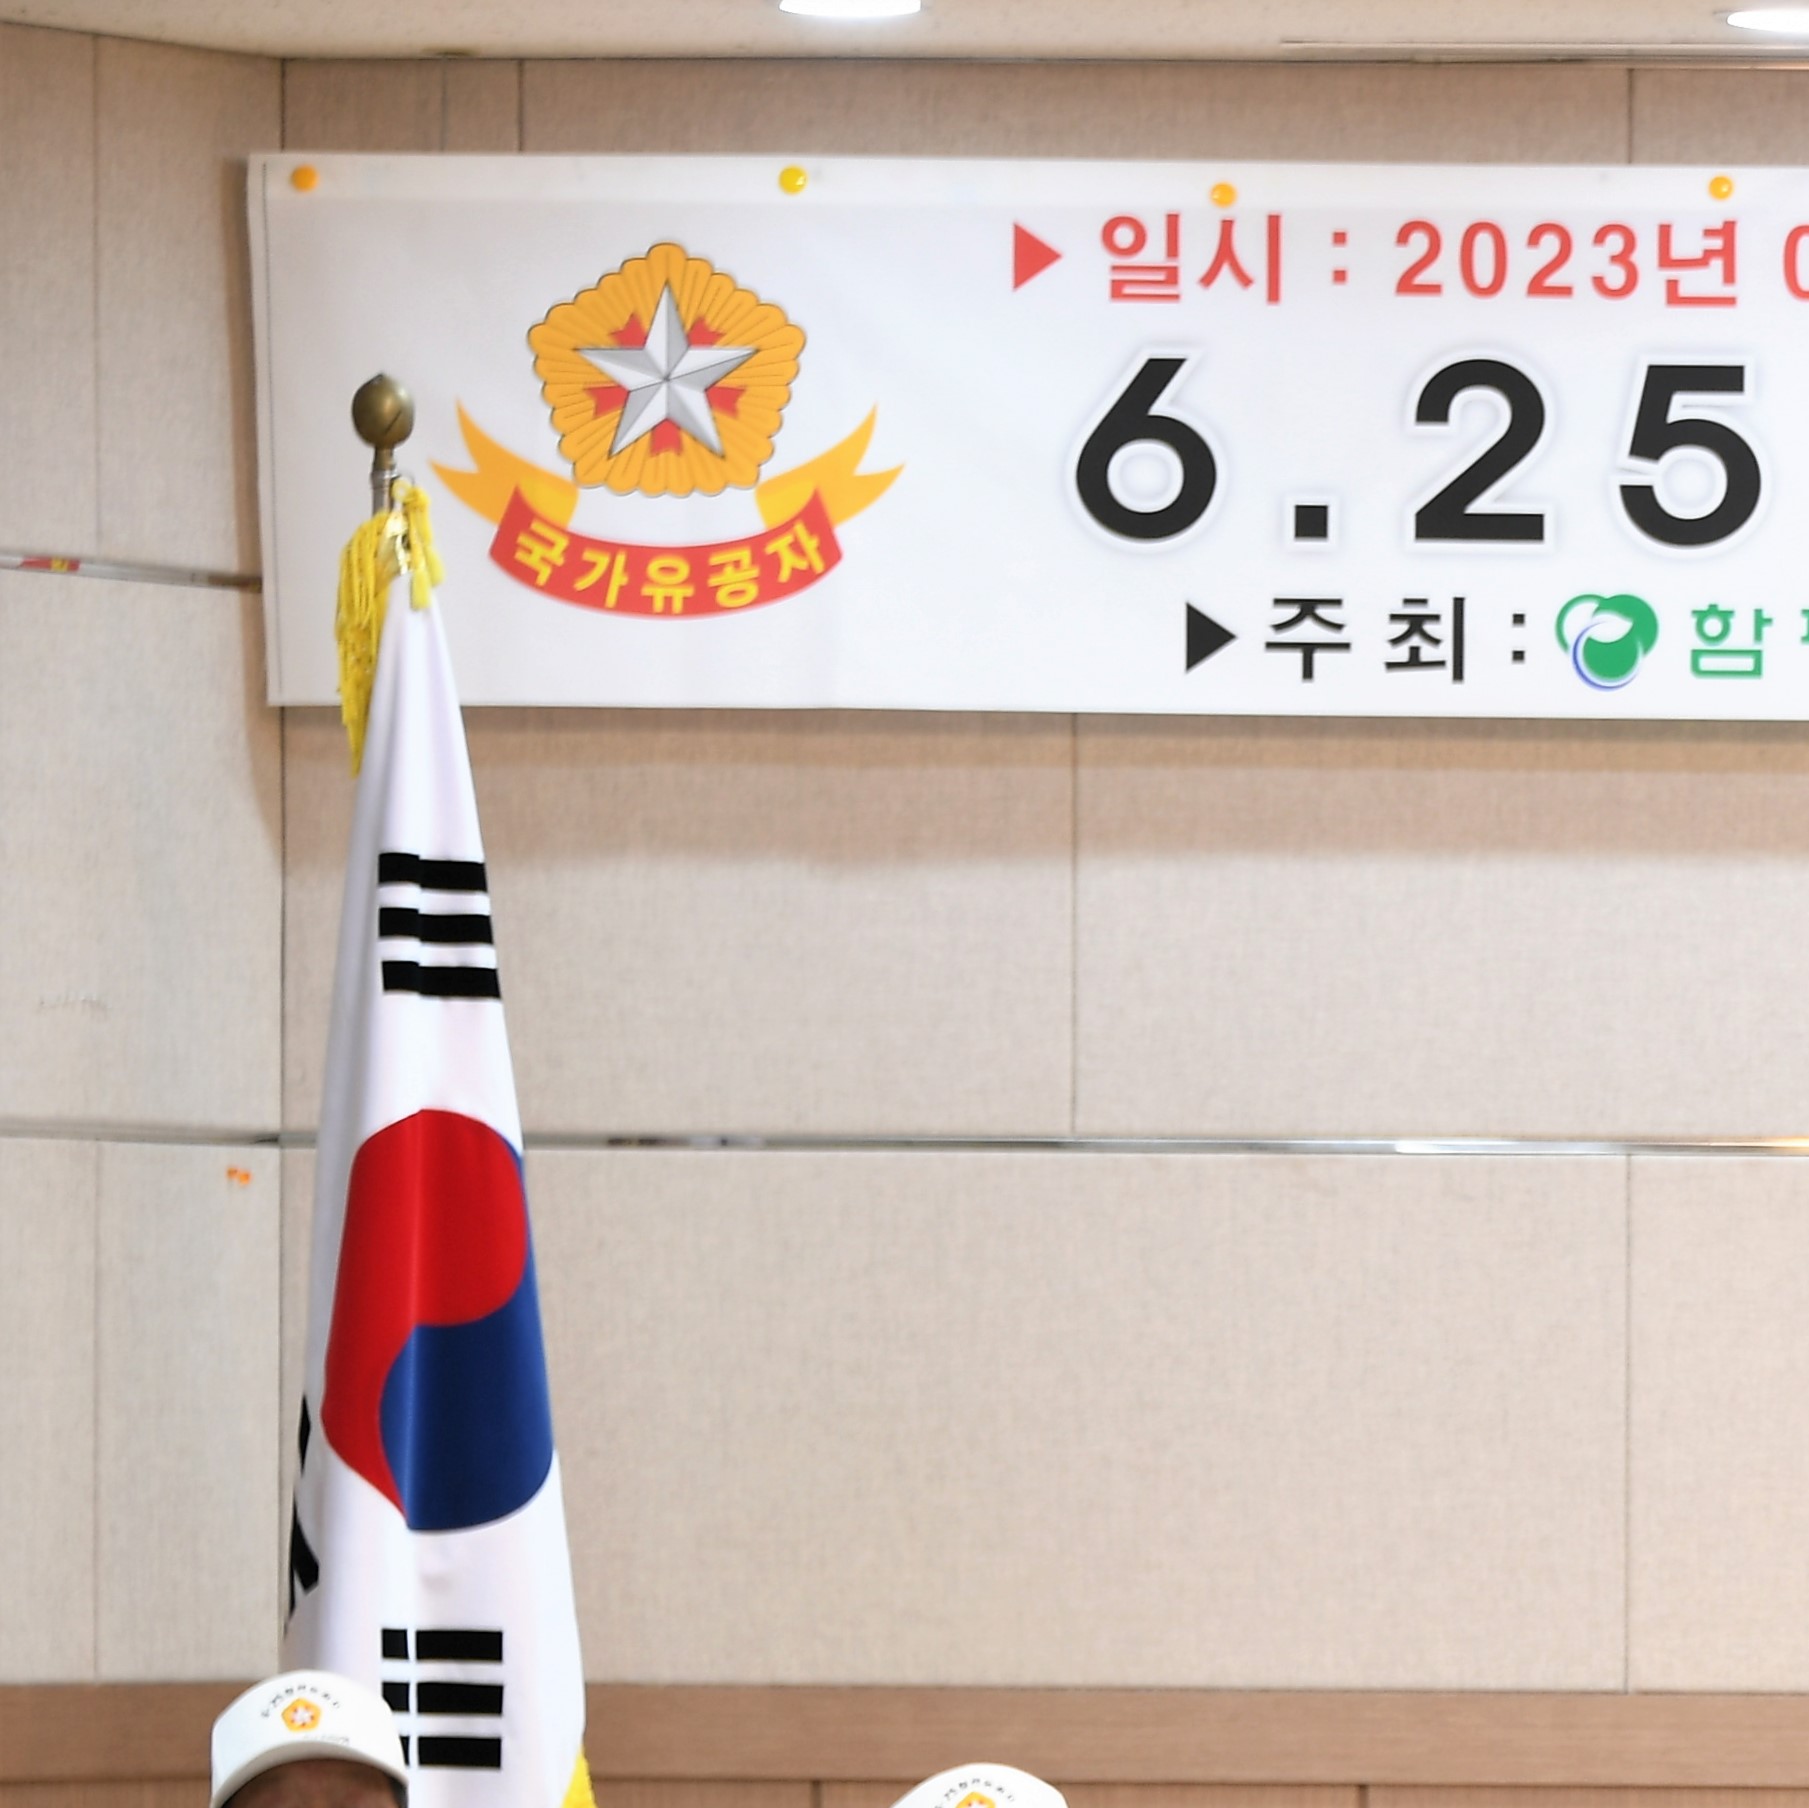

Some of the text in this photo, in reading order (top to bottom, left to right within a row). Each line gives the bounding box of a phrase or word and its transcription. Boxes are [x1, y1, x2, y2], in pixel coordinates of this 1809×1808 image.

[1100, 211, 1283, 305] 일시
[1395, 218, 1738, 309] 2023년
[515, 517, 826, 615] 국가유공자
